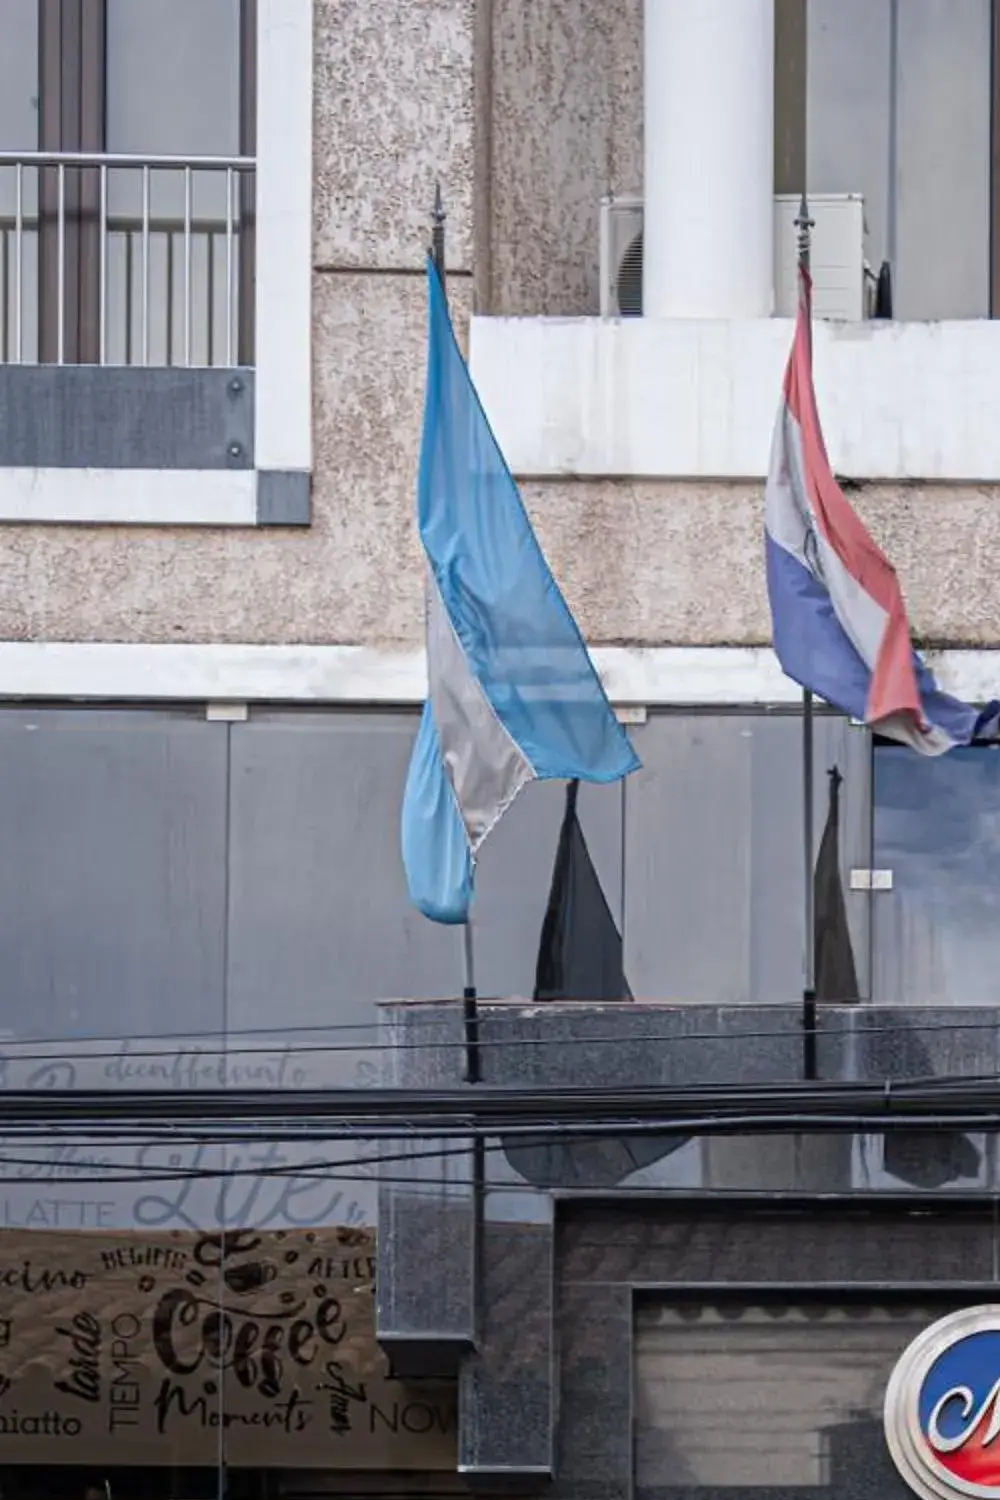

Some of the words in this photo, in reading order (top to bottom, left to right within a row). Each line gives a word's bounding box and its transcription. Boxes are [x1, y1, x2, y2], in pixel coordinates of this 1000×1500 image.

[5, 1199, 116, 1226] LATTE
[109, 1312, 141, 1434] TIEMPO
[154, 1288, 346, 1396] Coffee
[155, 1378, 313, 1434] Moments
